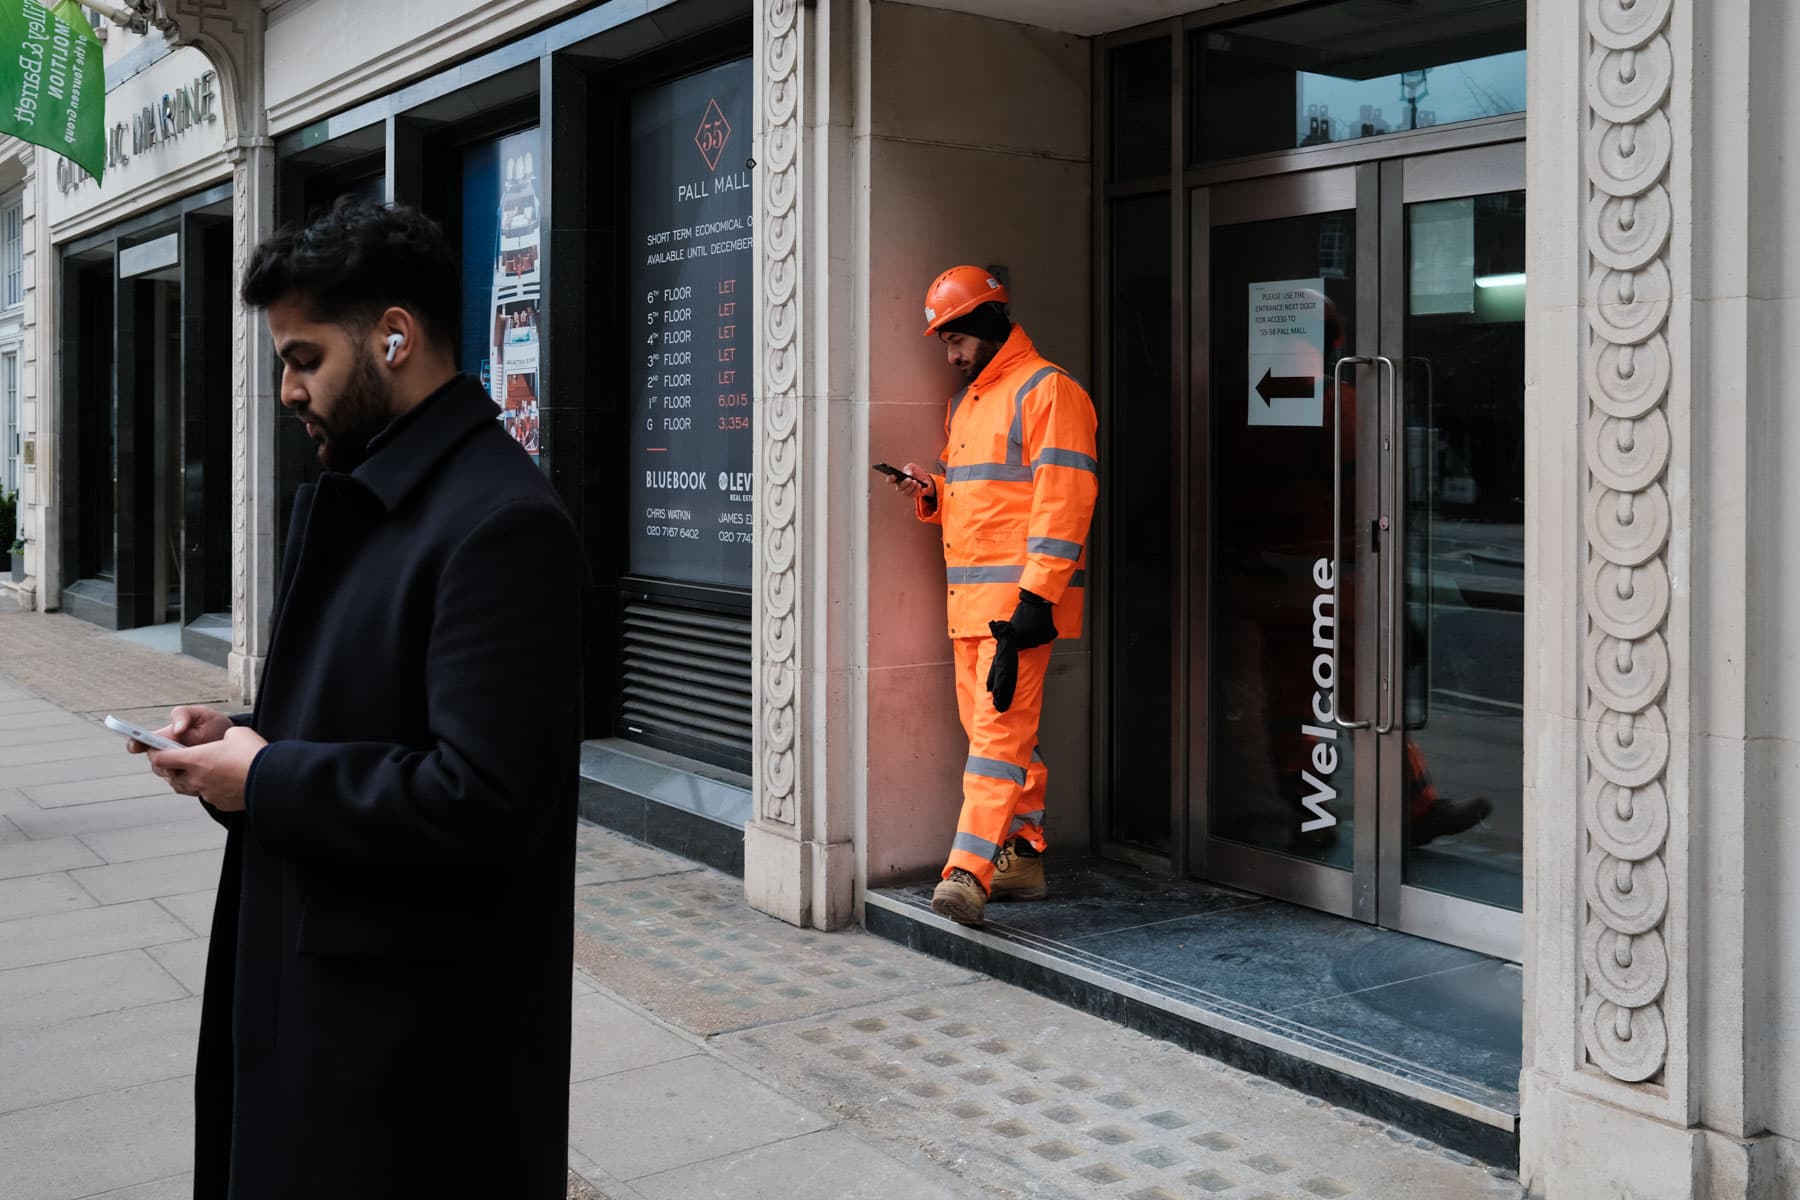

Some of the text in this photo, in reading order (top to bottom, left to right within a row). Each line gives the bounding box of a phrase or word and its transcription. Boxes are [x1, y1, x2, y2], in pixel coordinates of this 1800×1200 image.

[132, 69, 217, 156] MARINE
[702, 121, 723, 151] 55
[678, 171, 750, 202] PALL MALL
[647, 231, 671, 246] SHORT
[672, 227, 692, 242] TERM
[695, 217, 744, 237] ECONOMICAL
[646, 237, 753, 265] AVAILABLE UNTIL DECEMBER
[664, 286, 692, 301] FLOOR
[719, 280, 737, 294] LET
[1262, 290, 1305, 301] PLEASE USE THE
[664, 308, 692, 323] FLOOR
[719, 302, 737, 317] LET
[1255, 303, 1284, 313] ENTRANCE
[1284, 303, 1299, 311] NEXT
[1255, 314, 1296, 324] FOR ACCESS TO
[664, 330, 692, 344] FLOOR
[719, 325, 737, 339] LET
[1277, 327, 1290, 336] PALL
[1290, 327, 1307, 335] MALL
[664, 351, 692, 366] FLOOR
[719, 348, 737, 362] LET
[664, 374, 692, 388] FLOOR
[719, 370, 737, 384] LET
[664, 395, 692, 409] FLOOR
[646, 418, 653, 431] G
[664, 417, 692, 431] FLOOR
[646, 470, 707, 491] BLUEBOOK
[730, 472, 753, 492] LEV
[730, 494, 742, 502] REAL
[647, 508, 691, 521] CHRIS WATKIN
[718, 512, 744, 525] JAMES
[647, 525, 700, 539] 020 7167 6402
[718, 531, 734, 543] 020
[1301, 557, 1338, 833] Welcome
